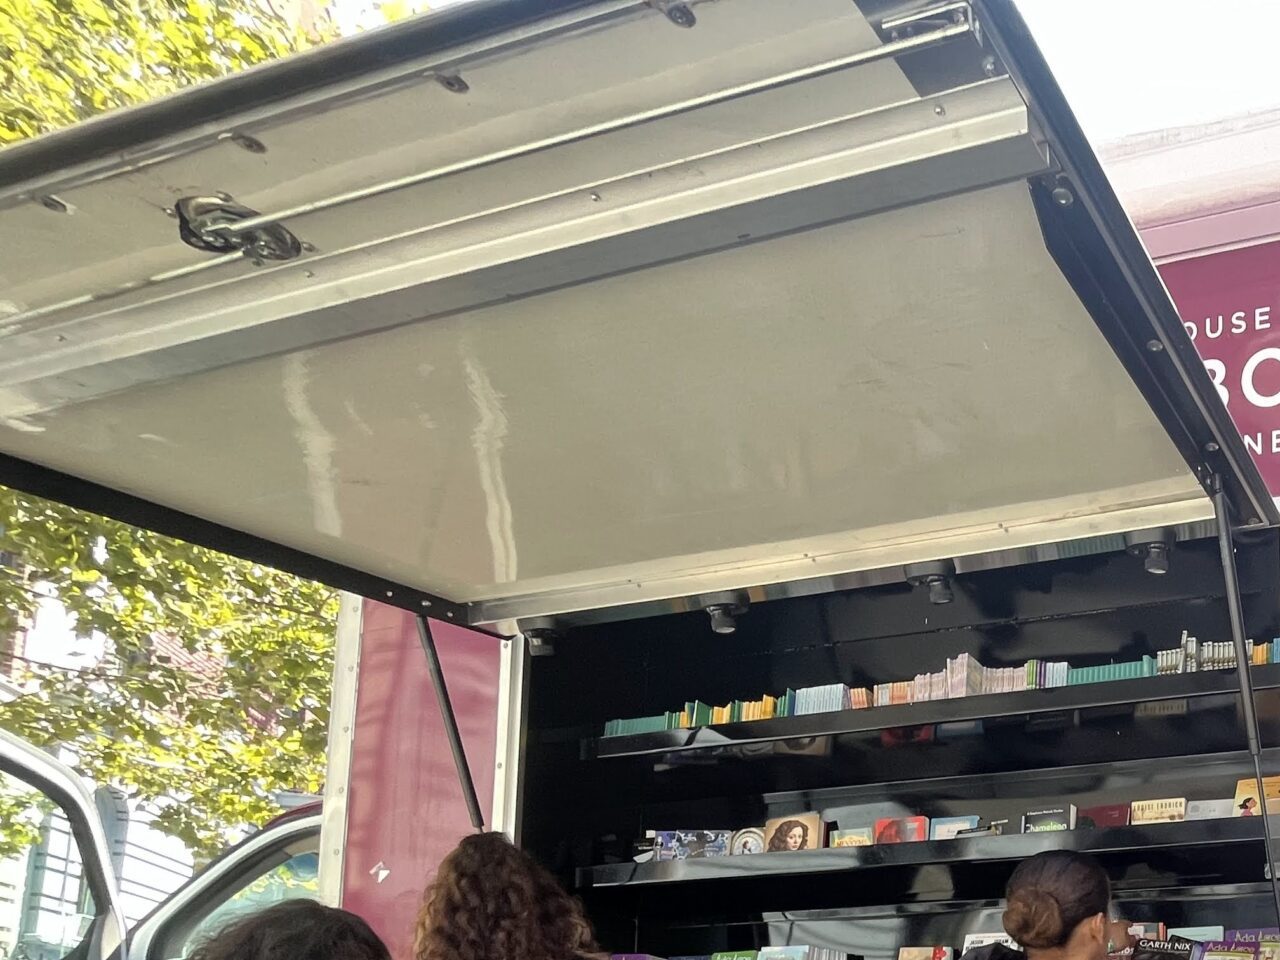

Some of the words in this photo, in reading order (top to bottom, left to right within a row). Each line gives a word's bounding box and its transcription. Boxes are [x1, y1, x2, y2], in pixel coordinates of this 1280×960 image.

[1025, 821, 1067, 833] Chameleon
[1139, 939, 1171, 950] GARTH
[1174, 942, 1191, 951] NIX
[1207, 942, 1228, 952] Ada
